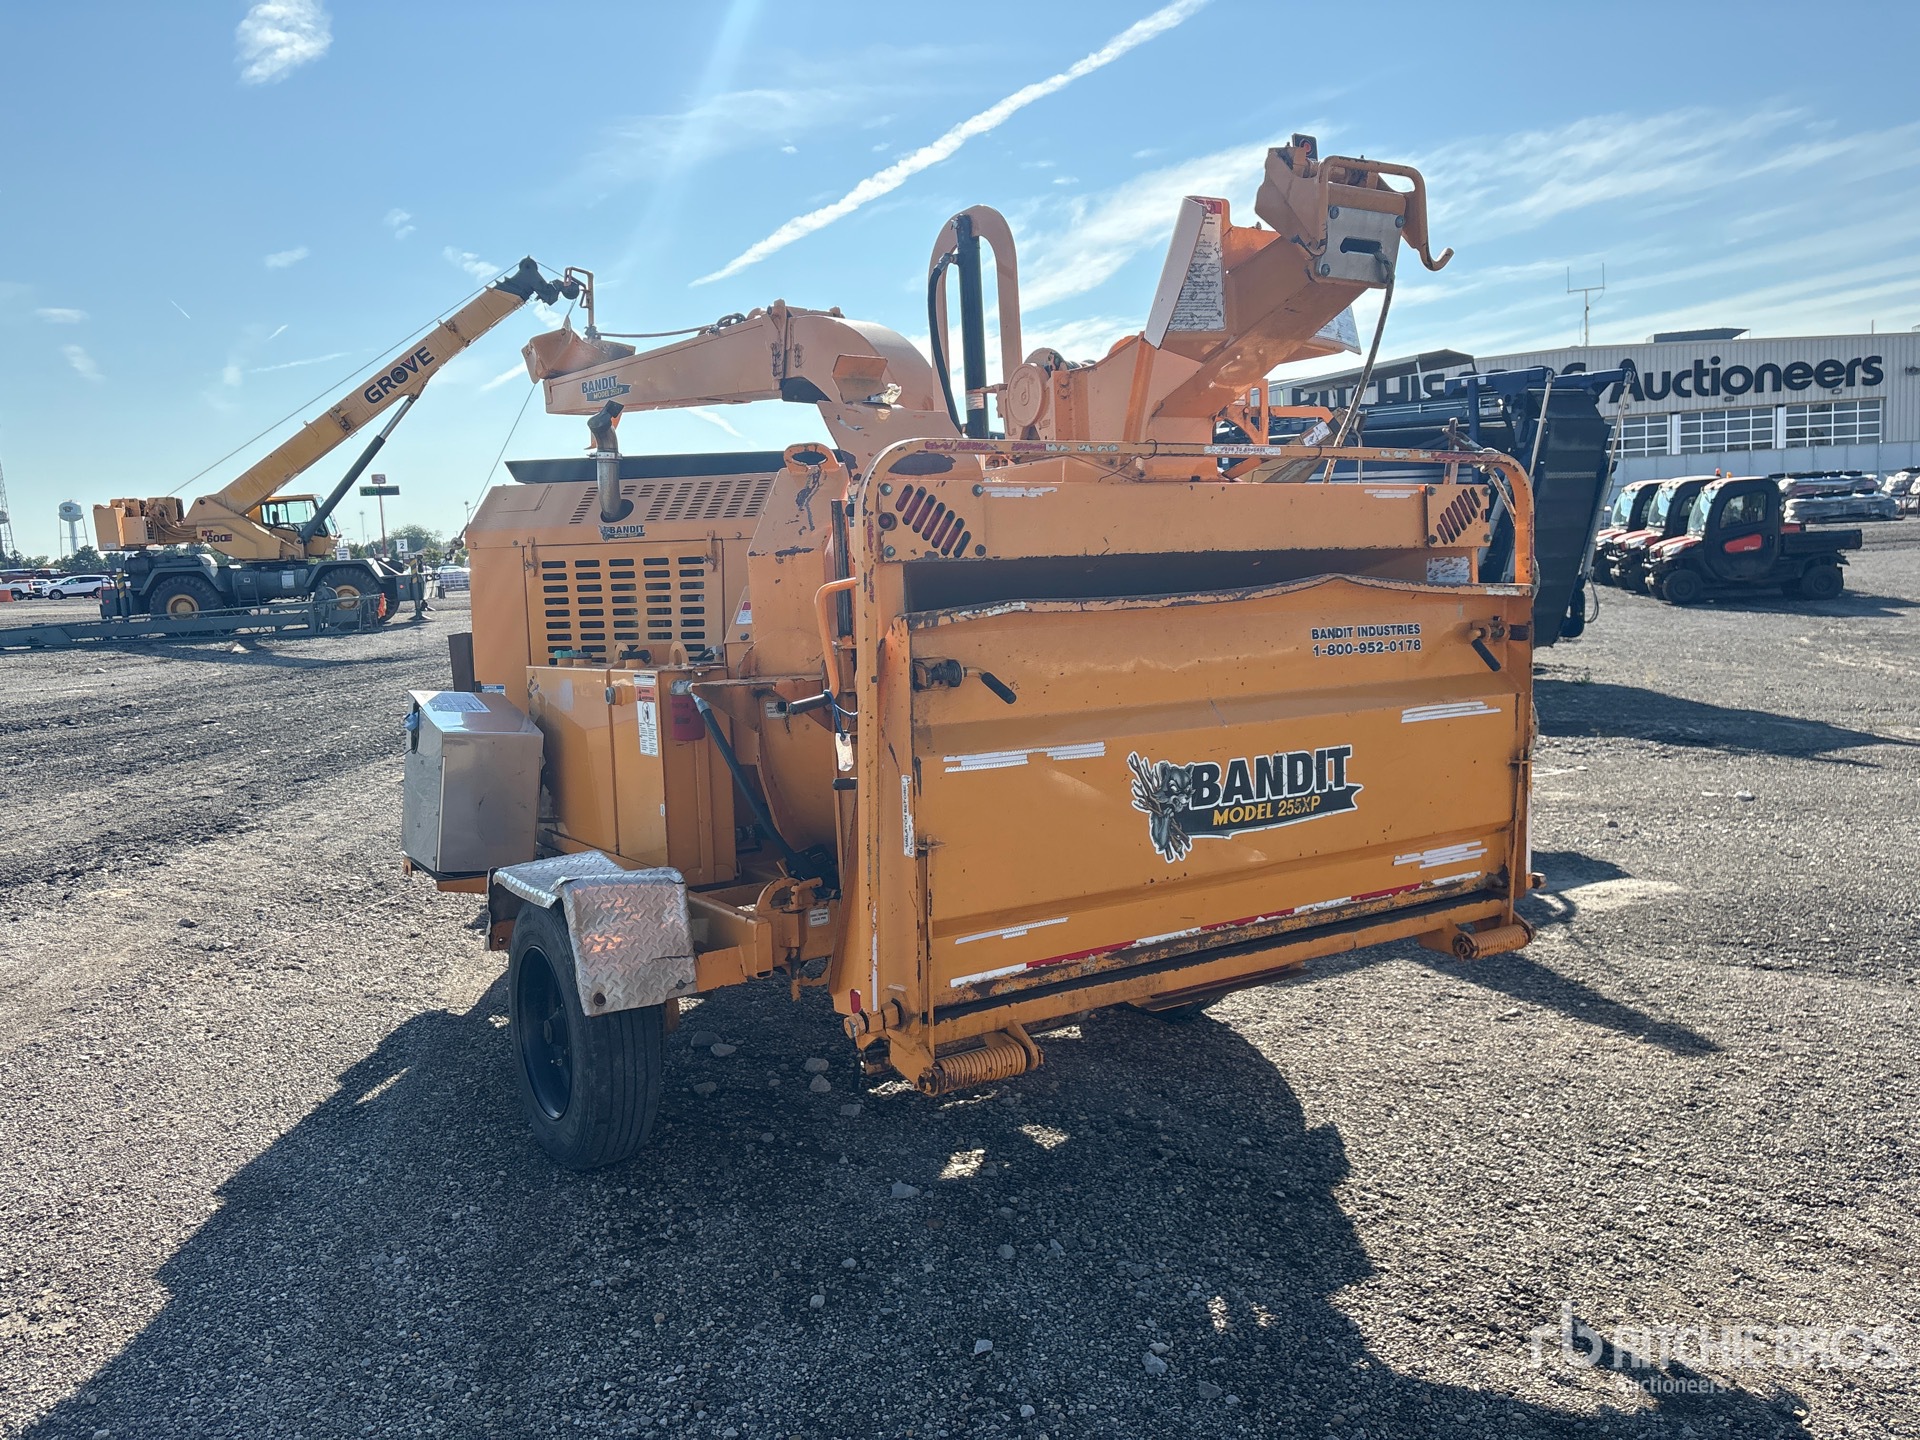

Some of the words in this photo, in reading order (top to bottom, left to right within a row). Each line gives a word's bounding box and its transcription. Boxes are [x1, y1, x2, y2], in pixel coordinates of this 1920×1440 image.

[363, 345, 436, 404] GROVE
[582, 375, 618, 394] BANDIT
[1608, 355, 1884, 403] Auctioneers
[610, 524, 645, 534] BANDIT
[1311, 626, 1353, 640] BANDIT
[1357, 623, 1421, 637] INDUSTRIES
[1313, 639, 1421, 657] 1-800-952-0178
[1191, 745, 1352, 809] BANDIT
[1212, 804, 1274, 826] MODEL
[1277, 795, 1321, 817] 255XP
